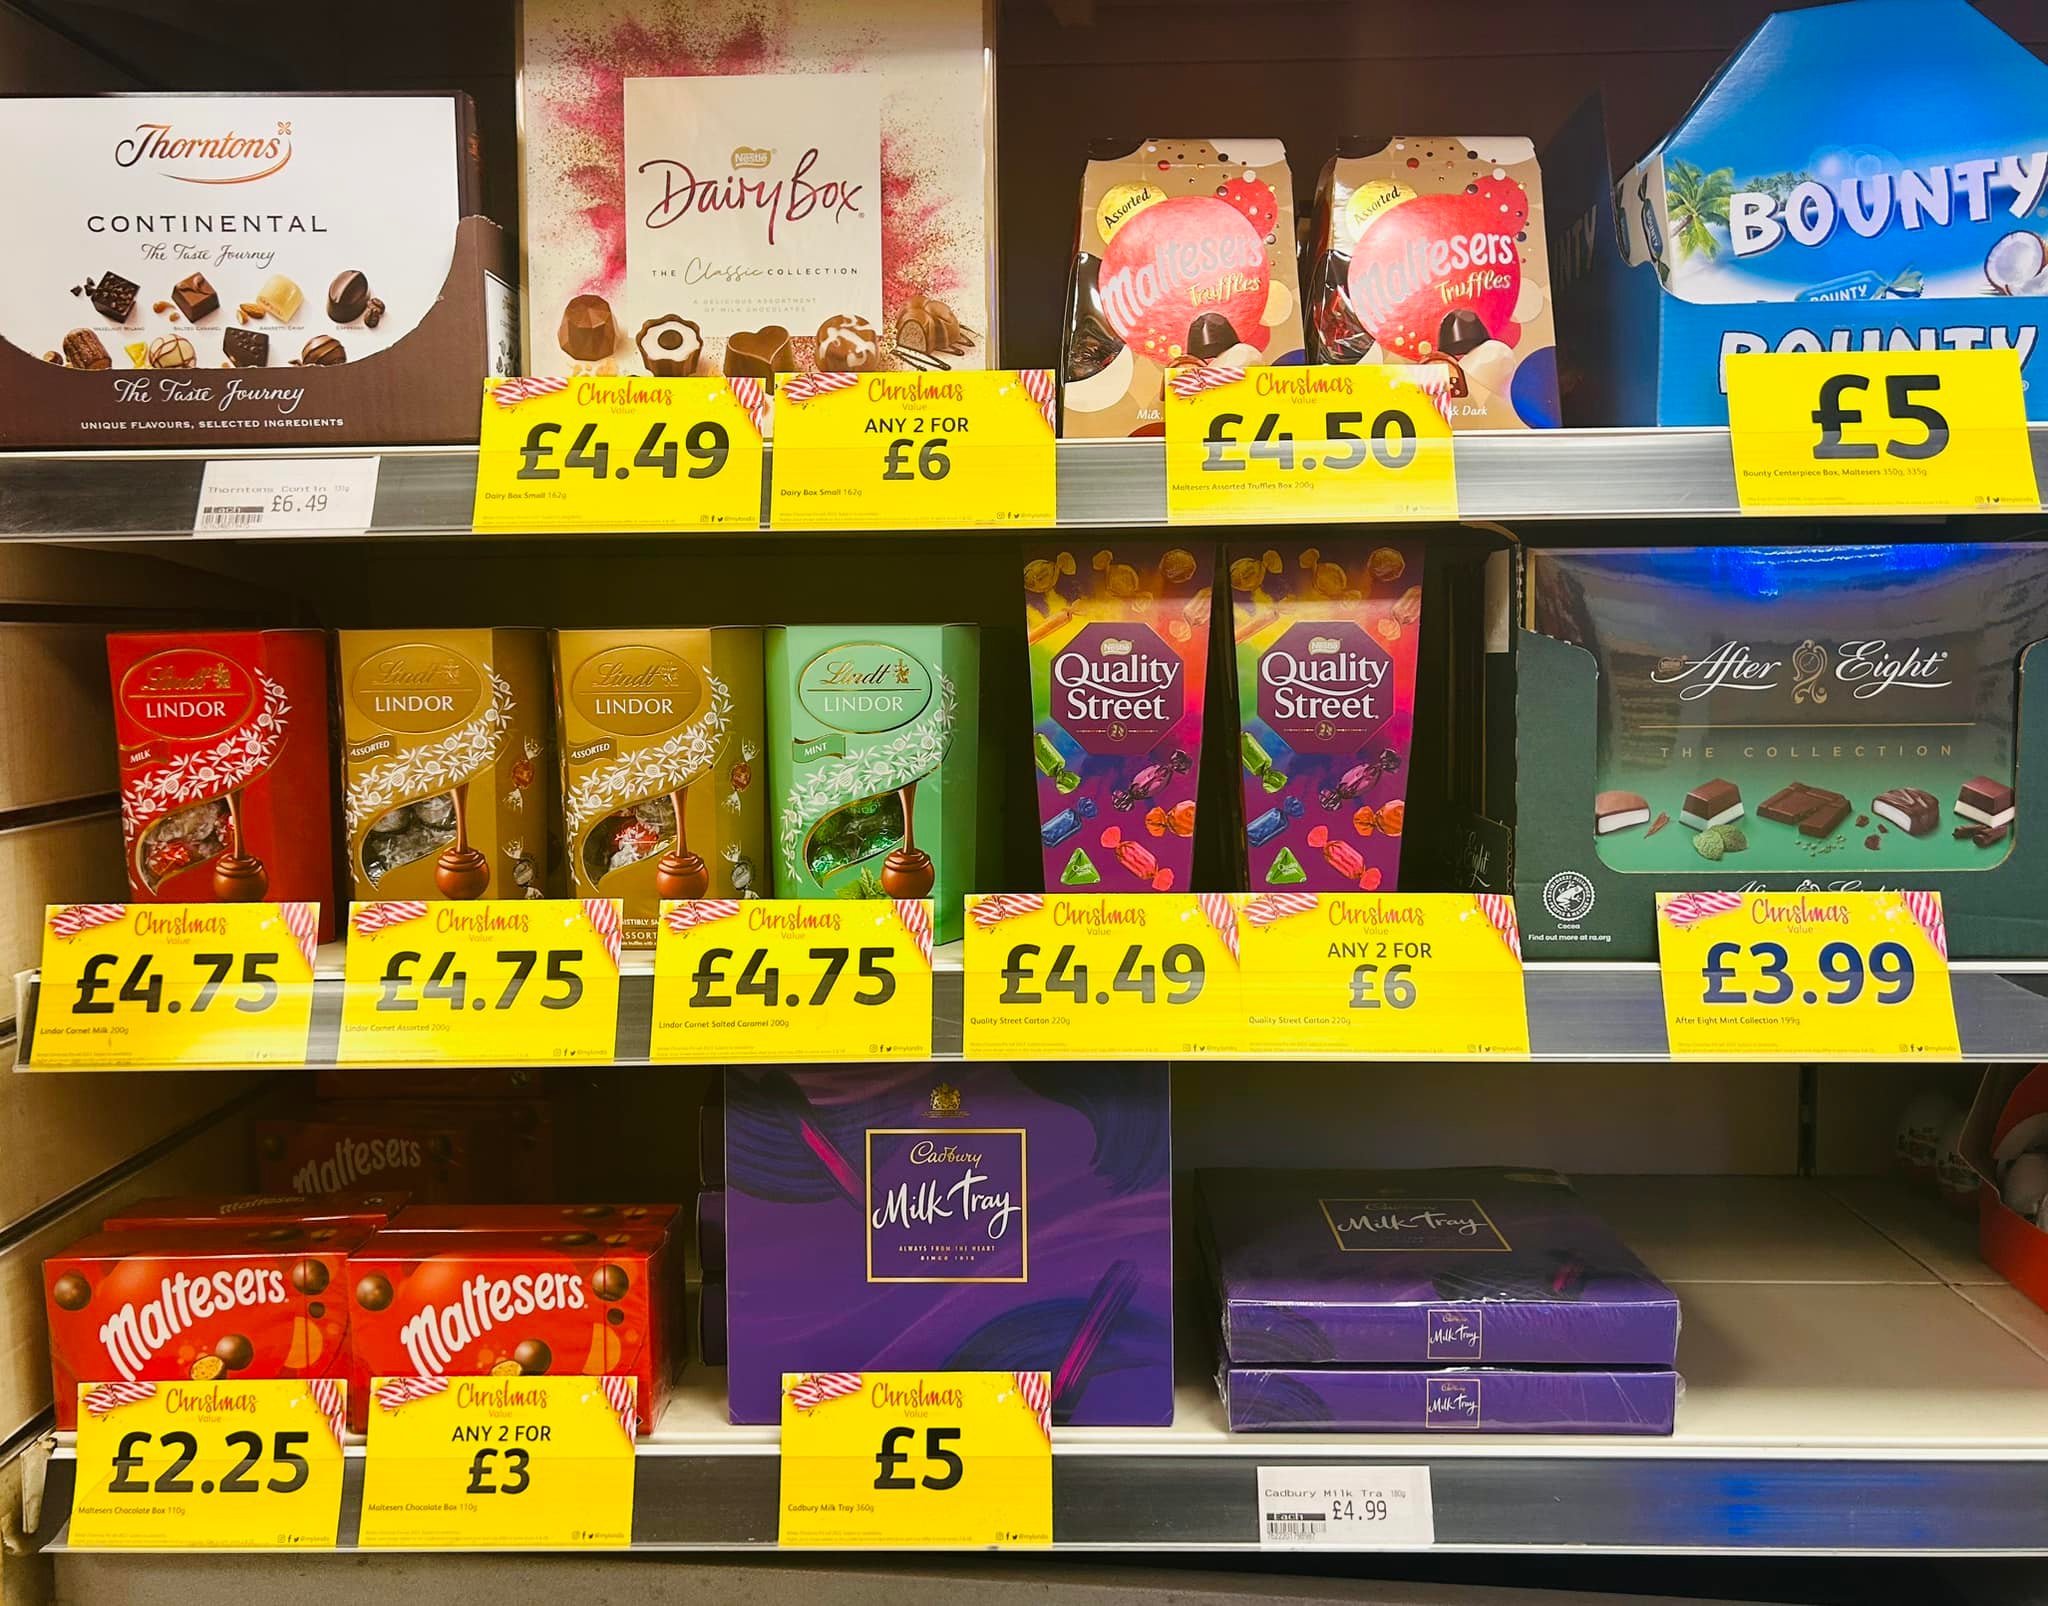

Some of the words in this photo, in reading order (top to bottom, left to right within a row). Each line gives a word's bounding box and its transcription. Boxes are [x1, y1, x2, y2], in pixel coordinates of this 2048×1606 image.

[115, 122, 292, 170] Thorntons
[638, 159, 783, 246] Dairy
[783, 148, 863, 224] Box
[1104, 187, 1151, 229] Assorted
[1354, 186, 1401, 223] Assorted
[1729, 151, 2048, 257] BOUNTY
[87, 215, 328, 233] CONTINENTAL
[141, 243, 168, 261] The
[174, 243, 211, 261] Taste
[214, 244, 275, 269] Journey
[684, 257, 764, 285] Classic
[1187, 271, 1260, 306] Truffles
[1435, 270, 1511, 304] Truffles
[577, 381, 672, 406] Christmas
[868, 375, 963, 402] Christmas
[1256, 368, 1353, 397] Christmas
[114, 379, 151, 403] The
[160, 380, 213, 402] Taste
[218, 379, 305, 414] Journey
[81, 421, 128, 430] UNIQUE
[131, 420, 195, 431] FLAVOURS,
[199, 419, 260, 429] SELECTED
[263, 418, 344, 428] INGREDIENTS
[864, 418, 906, 433] ANY
[913, 418, 924, 433] 2
[931, 417, 969, 433] FOR
[1811, 374, 1950, 460] £5
[516, 421, 730, 480] £4.49
[1201, 410, 1417, 472] £4.50
[882, 438, 951, 481] £6
[1743, 470, 1772, 478] Bounty
[1774, 469, 1821, 478] Centerpiece
[1823, 468, 1841, 477] Box,
[1842, 468, 1881, 476] Maltesers
[208, 486, 274, 494] Thorntons
[485, 492, 505, 500] Dairy
[524, 491, 546, 499] Small
[780, 489, 801, 497] Dairy
[803, 488, 818, 496] Box
[819, 488, 841, 496] Small
[1172, 483, 1210, 491] Maltesers
[1211, 482, 1246, 490] Assorted
[1247, 481, 1276, 490] Truffles
[1277, 481, 1292, 489] Box
[271, 494, 328, 513] £6.49
[592, 661, 658, 689] Lindt
[821, 659, 888, 686] Lindt
[1054, 653, 1180, 697] Quality
[1262, 651, 1389, 696] Quality
[1651, 640, 1782, 701] After
[1835, 640, 1952, 700] Eight
[146, 700, 226, 719] LINDOR
[375, 695, 455, 713] LINDOR
[595, 698, 673, 715] LINDOR
[824, 696, 903, 713] LINDOR
[1067, 688, 1167, 720] Street
[1275, 687, 1375, 719] Street
[130, 748, 151, 764] MILK
[351, 739, 390, 757] ASSORTED
[571, 741, 611, 760] ASSORTED
[804, 742, 828, 757] MINT
[1660, 747, 1713, 758] THE
[1743, 745, 1951, 758] COLLECTION
[134, 908, 227, 936] Christmas
[436, 905, 529, 933] Christmas
[749, 905, 842, 931] Christmas
[1053, 899, 1146, 927] Christmas
[1328, 898, 1425, 927] Christmas
[1752, 896, 1850, 925] Christmas
[1327, 942, 1369, 958] ANY
[1376, 942, 1387, 958] 2
[1394, 942, 1432, 958] FOR
[72, 952, 279, 1014] £4.75
[376, 950, 584, 1011] £4.75
[689, 947, 896, 1008] £4.75
[999, 943, 1206, 1005] £4.49
[1349, 964, 1417, 1009] £6
[1702, 942, 1915, 1005] £3.99
[110, 1027, 129, 1035] 200g
[345, 1024, 369, 1032] Lindor
[370, 1024, 395, 1032] Cornet
[396, 1023, 430, 1031] Assorted
[431, 1023, 451, 1033] 200g
[658, 1021, 683, 1029] Lindor
[684, 1021, 710, 1029] Cornet
[711, 1020, 735, 1028] Salted
[770, 1019, 789, 1029] 200g
[970, 1017, 998, 1026] Quality
[999, 1017, 1022, 1025] Street
[1024, 1017, 1050, 1025] Carton
[1051, 1017, 1071, 1026] 220g
[1249, 1017, 1276, 1025] Quality
[1697, 1017, 1717, 1025] Eight
[1780, 1017, 1800, 1025] 199g
[910, 1141, 982, 1168] Cadbury
[872, 1180, 953, 1229] Milk
[947, 1169, 1021, 1239] Tray
[1337, 1215, 1418, 1232] Milk
[1410, 1211, 1488, 1236] Tray
[1430, 1328, 1457, 1344] Milk
[1455, 1324, 1480, 1347] Tray
[166, 1386, 257, 1414] Christmas
[457, 1380, 547, 1409] Christmas
[871, 1379, 964, 1409] Christmas
[1428, 1397, 1455, 1413] Milk
[1453, 1393, 1478, 1416] Tray
[451, 1426, 492, 1441] ANY
[498, 1426, 508, 1441] 2
[515, 1426, 551, 1441] FOR
[108, 1431, 309, 1494] £2.25
[466, 1448, 530, 1494] £3
[874, 1426, 963, 1490] £5
[405, 1503, 442, 1511] Chocolate
[443, 1503, 457, 1511] Box
[1265, 1489, 1316, 1498] Cadbury
[1324, 1489, 1352, 1497] Milk
[1362, 1489, 1383, 1497] Tra
[114, 1506, 150, 1514] Chocolate
[167, 1507, 186, 1515] 110g
[788, 1504, 818, 1513] Cadbury
[838, 1504, 853, 1513] Tray
[855, 1504, 874, 1513] 360g
[1333, 1500, 1387, 1520] £4.99
